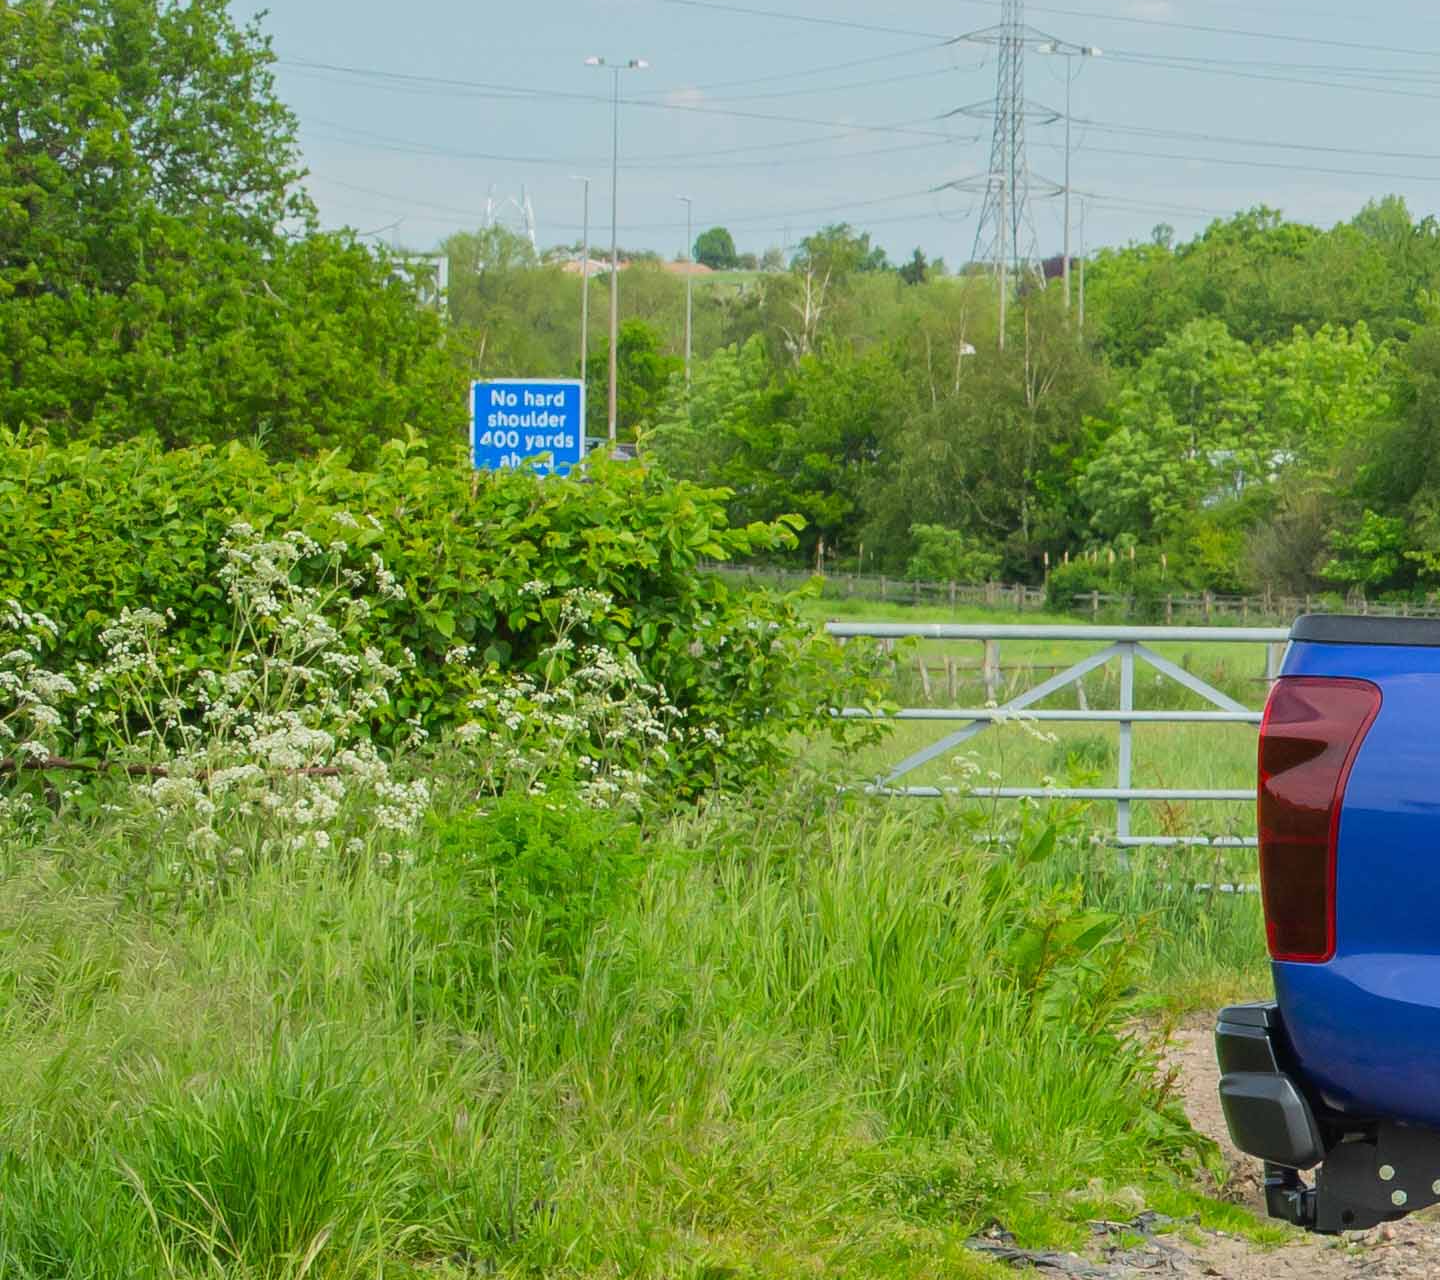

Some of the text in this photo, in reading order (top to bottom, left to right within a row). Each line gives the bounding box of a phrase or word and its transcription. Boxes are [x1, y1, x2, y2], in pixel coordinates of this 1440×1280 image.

[490, 390, 565, 407] No hard
[487, 411, 567, 428] shoulder
[480, 431, 574, 451] 400 yards
[500, 452, 555, 469] ahd
